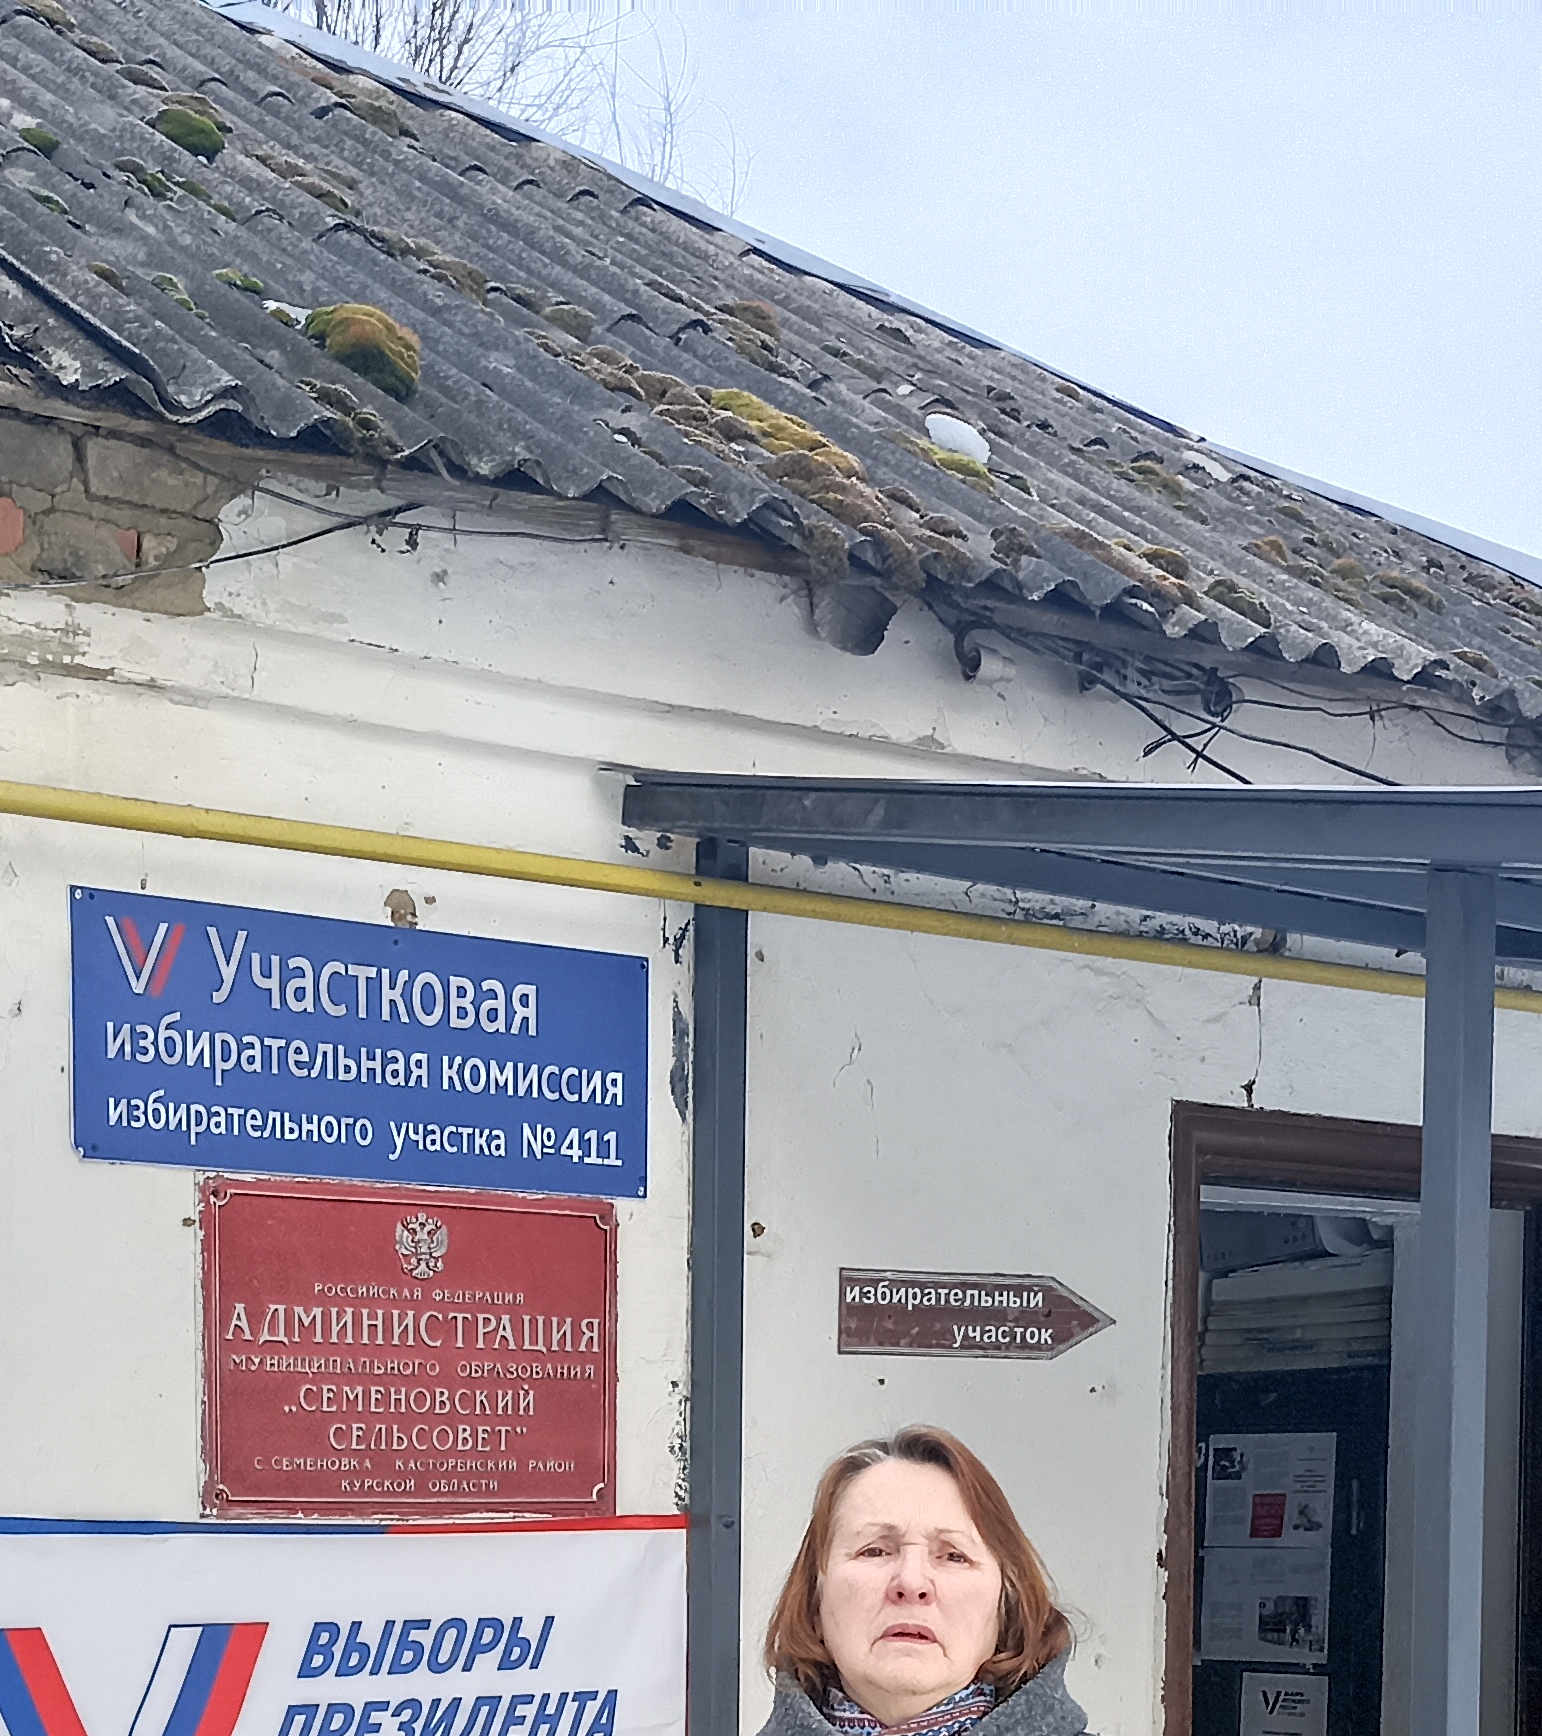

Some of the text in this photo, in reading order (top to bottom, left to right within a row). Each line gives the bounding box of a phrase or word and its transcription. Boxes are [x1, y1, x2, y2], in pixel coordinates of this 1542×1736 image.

[207, 925, 538, 1037] Участковая
[106, 1012, 624, 1107] избирательная комиссия
[108, 1090, 623, 1167] избирательного участка №411
[314, 1282, 524, 1306] РОССИЙСКАЯ ФЕДЕРАЦИЯ
[845, 1281, 1043, 1309] избирательный
[225, 1303, 600, 1354] АДМИНИСТРАЦИЯ
[952, 1324, 1053, 1347] участок
[229, 1354, 595, 1380] МУНИЦИПАЛЬНОГО ОБРАЗОВАНИЯ
[272, 1457, 372, 1471] СЕМЕНОВКА
[395, 1457, 517, 1472] КАСТОРЕНСКИЙ
[529, 1458, 575, 1472] РАЙОН
[341, 1478, 498, 1492] КУРСКОЙ ОБЛАСТИ
[297, 1615, 555, 1679] ВЫБОРЫ
